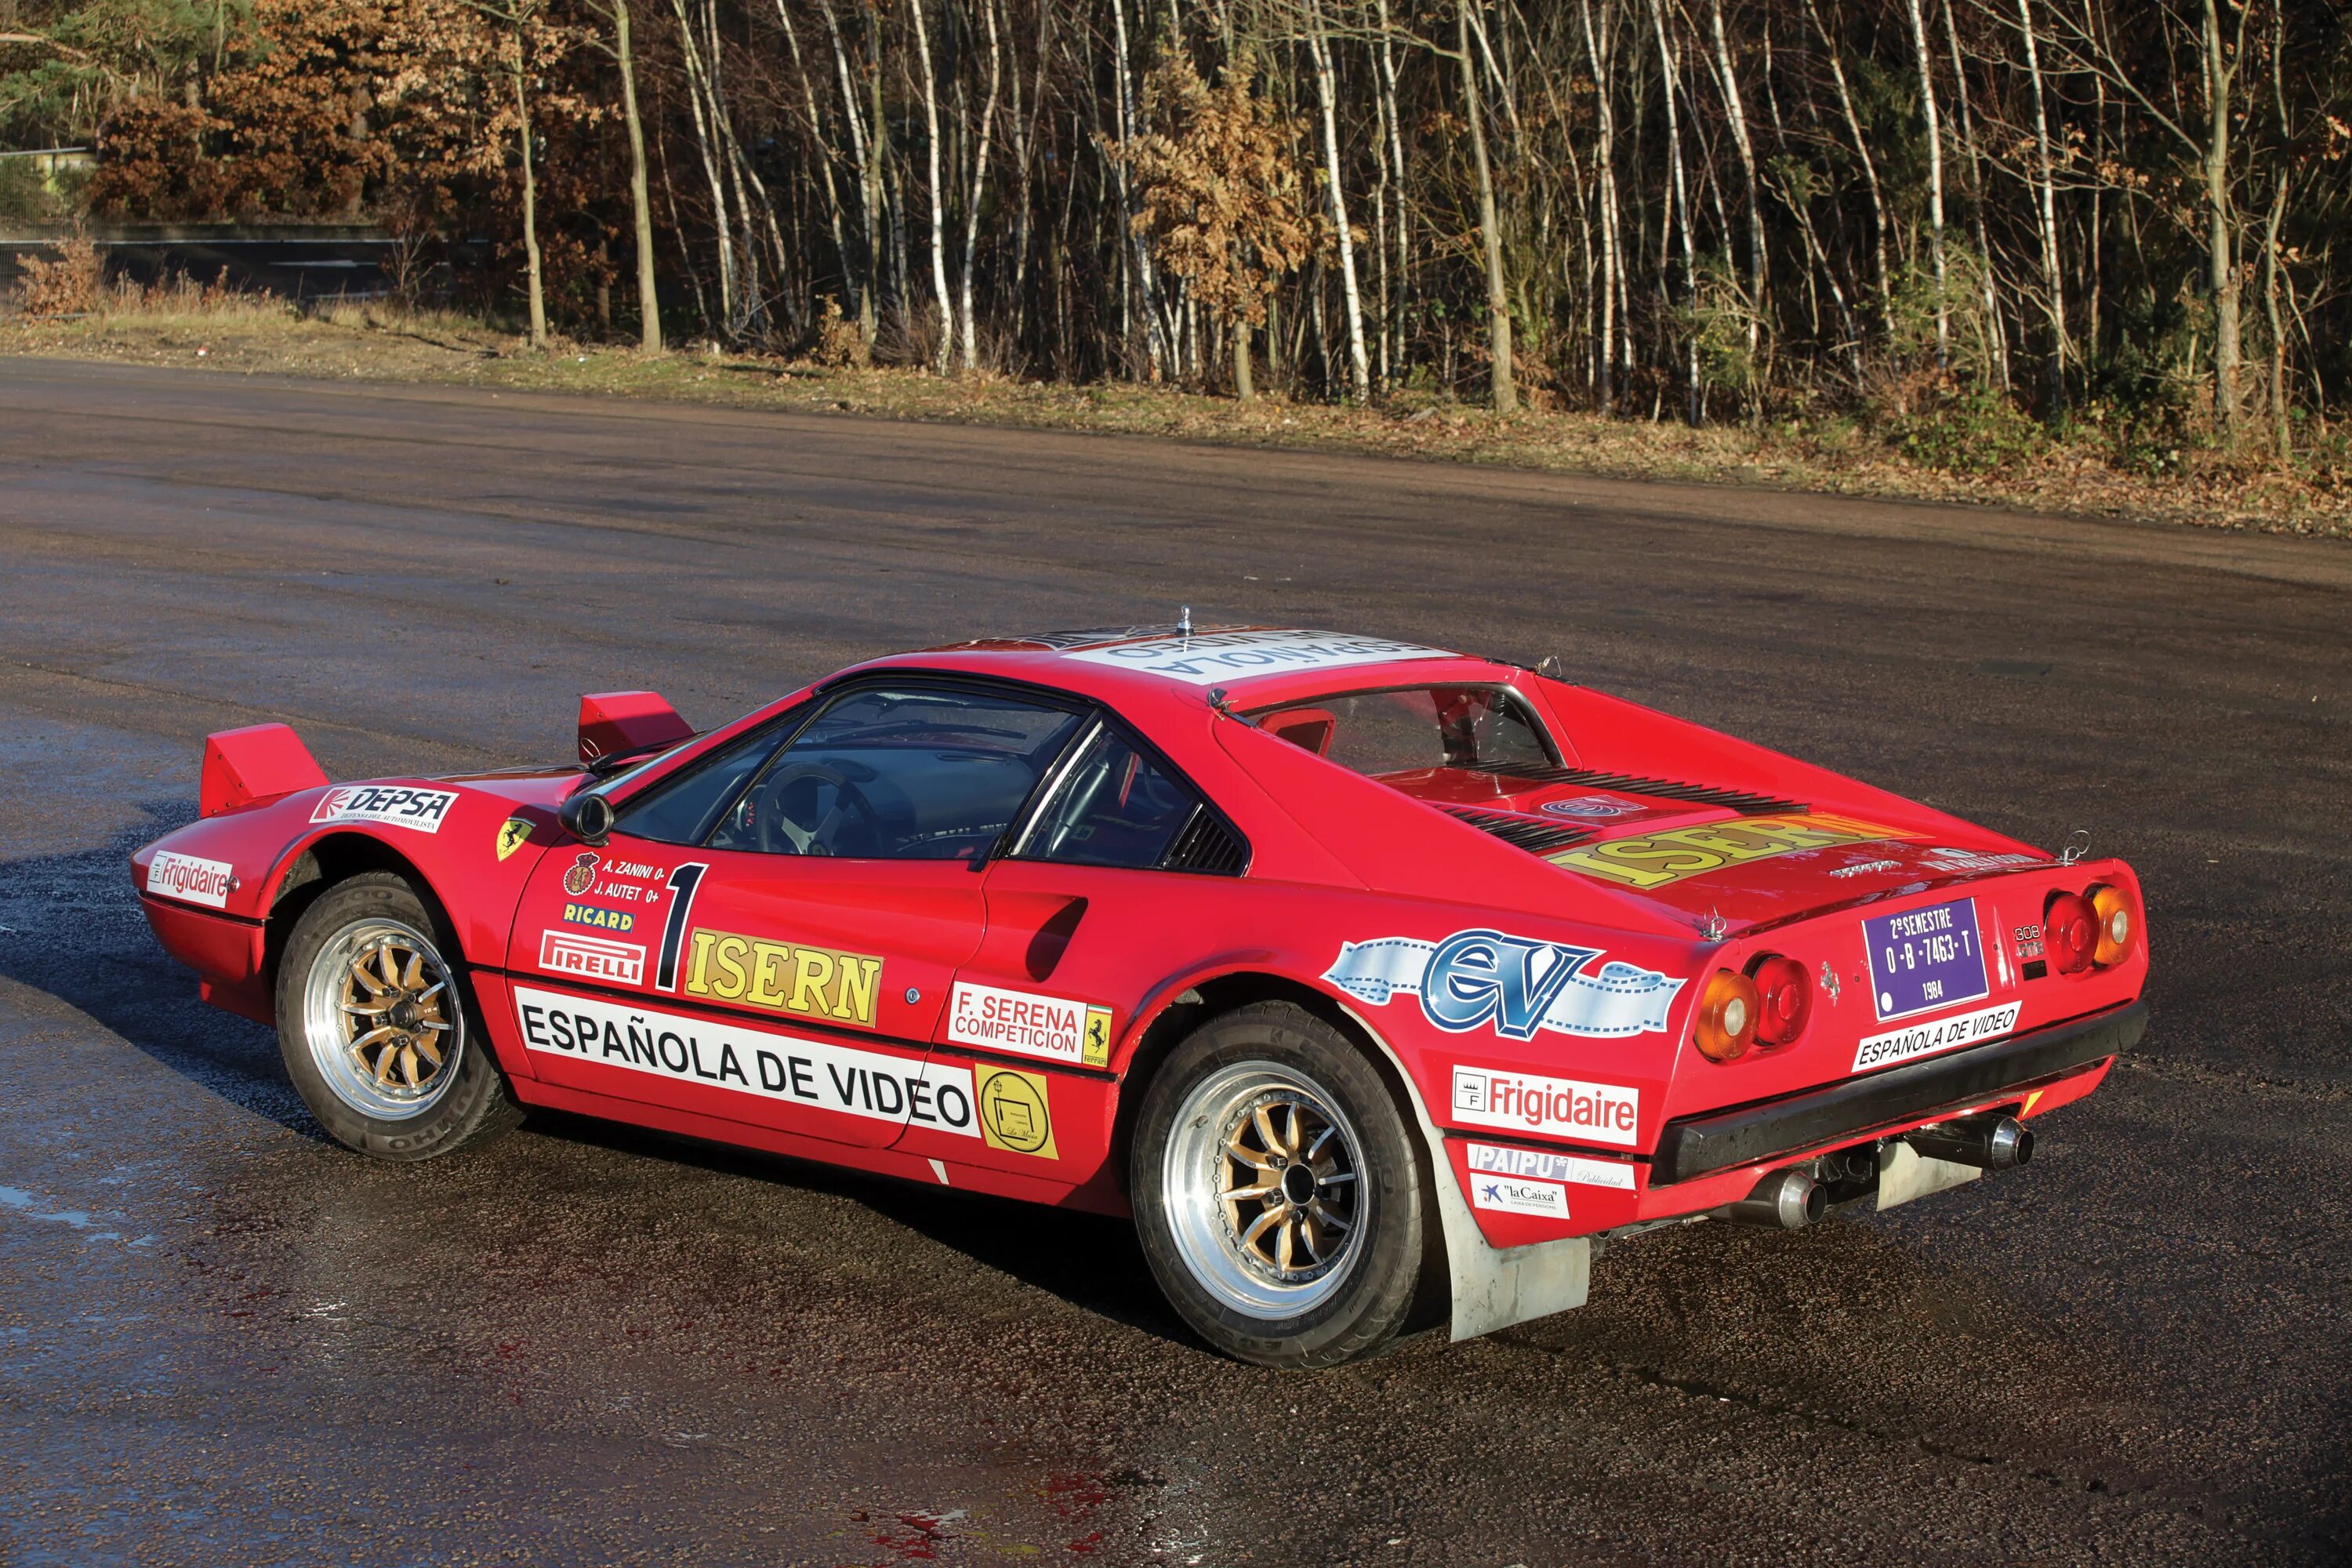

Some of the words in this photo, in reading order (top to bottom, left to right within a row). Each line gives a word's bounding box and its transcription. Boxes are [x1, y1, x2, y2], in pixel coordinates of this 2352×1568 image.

[346, 788, 452, 820] DEPSA
[382, 815, 435, 829] AUTOMOVILISTA
[602, 859, 614, 873] A.
[615, 860, 654, 879] ZANINI
[1548, 813, 1919, 887] ISERN
[162, 858, 227, 897] Frigidaire
[593, 883, 604, 896] J.
[604, 884, 642, 902] AUTET
[564, 903, 633, 931] RICARD
[655, 862, 710, 993] 1
[2013, 925, 2041, 942] 308
[543, 935, 641, 980] PIRELLI
[687, 931, 880, 1022] ISERN
[1922, 980, 1943, 1000] 1984
[957, 991, 973, 1016] F.
[982, 996, 1078, 1034] SERENA
[955, 1016, 1076, 1053] COMPETICION
[1859, 1028, 1942, 1065] ESPAÑOLA
[1947, 1020, 1970, 1043] DE
[1972, 1008, 2015, 1036] VIDEO
[522, 1004, 749, 1086] ESPAÑOLA
[757, 1050, 818, 1100] DE
[827, 1063, 971, 1127] VIDEO
[1490, 1077, 1635, 1131] Frigidaire
